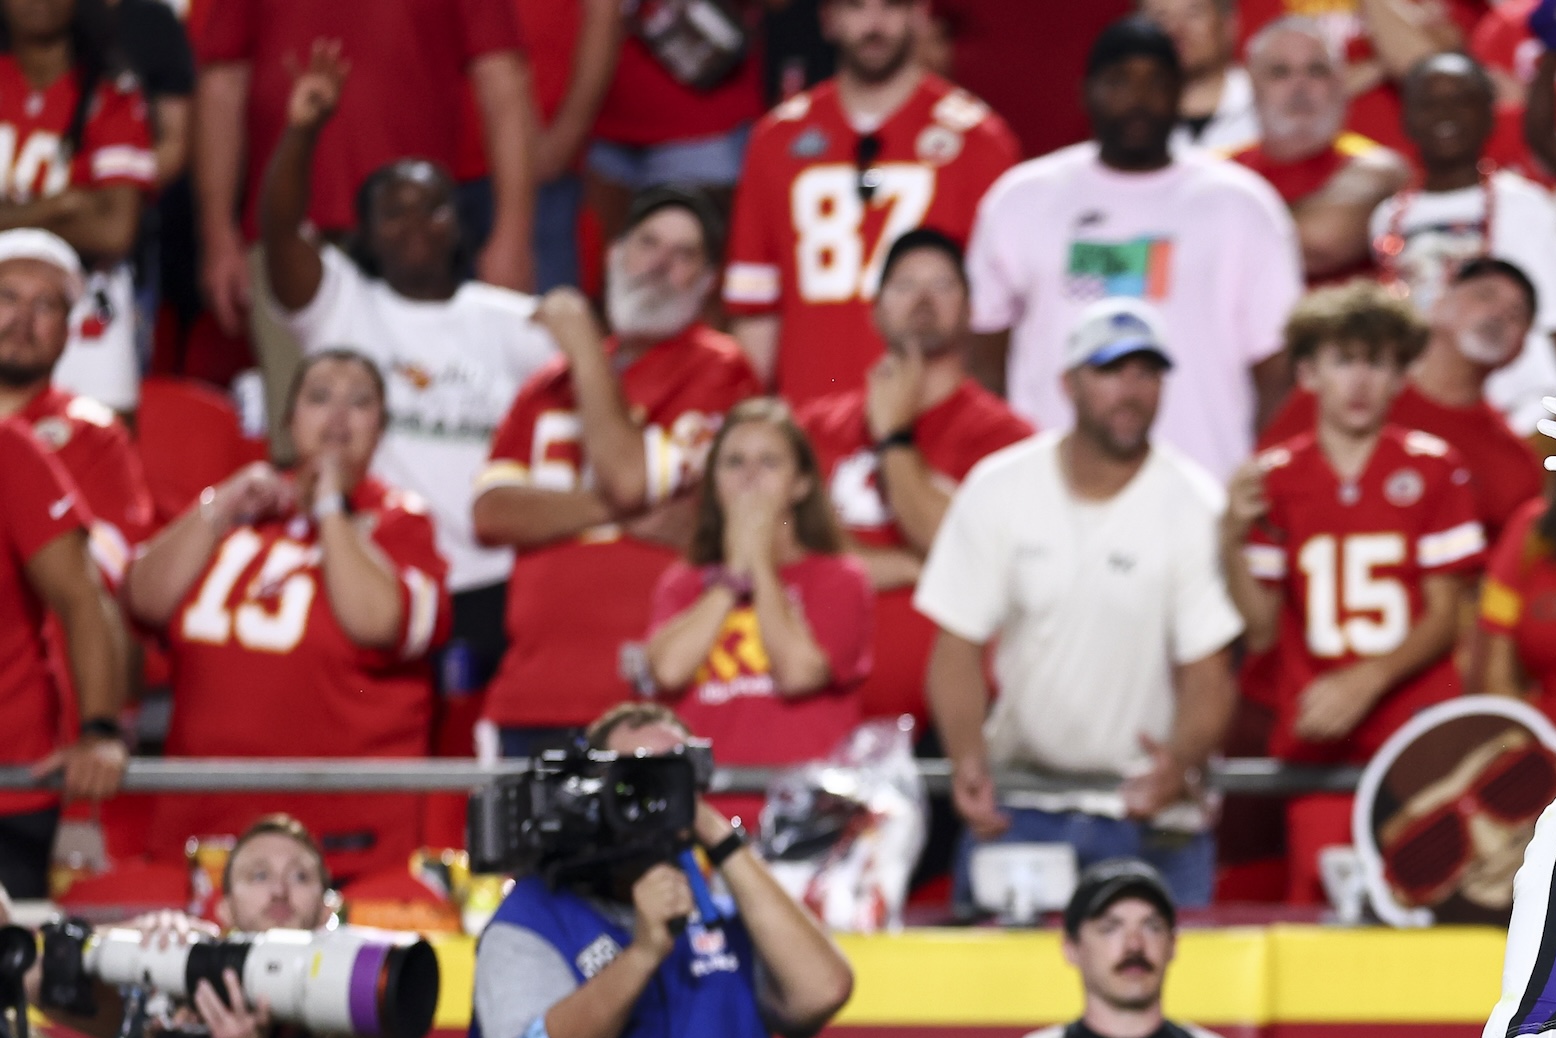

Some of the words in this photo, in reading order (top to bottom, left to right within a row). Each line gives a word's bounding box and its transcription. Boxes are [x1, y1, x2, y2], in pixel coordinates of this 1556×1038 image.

[789, 161, 937, 303] 87
[181, 527, 318, 654] 15
[1299, 532, 1413, 659] 15
